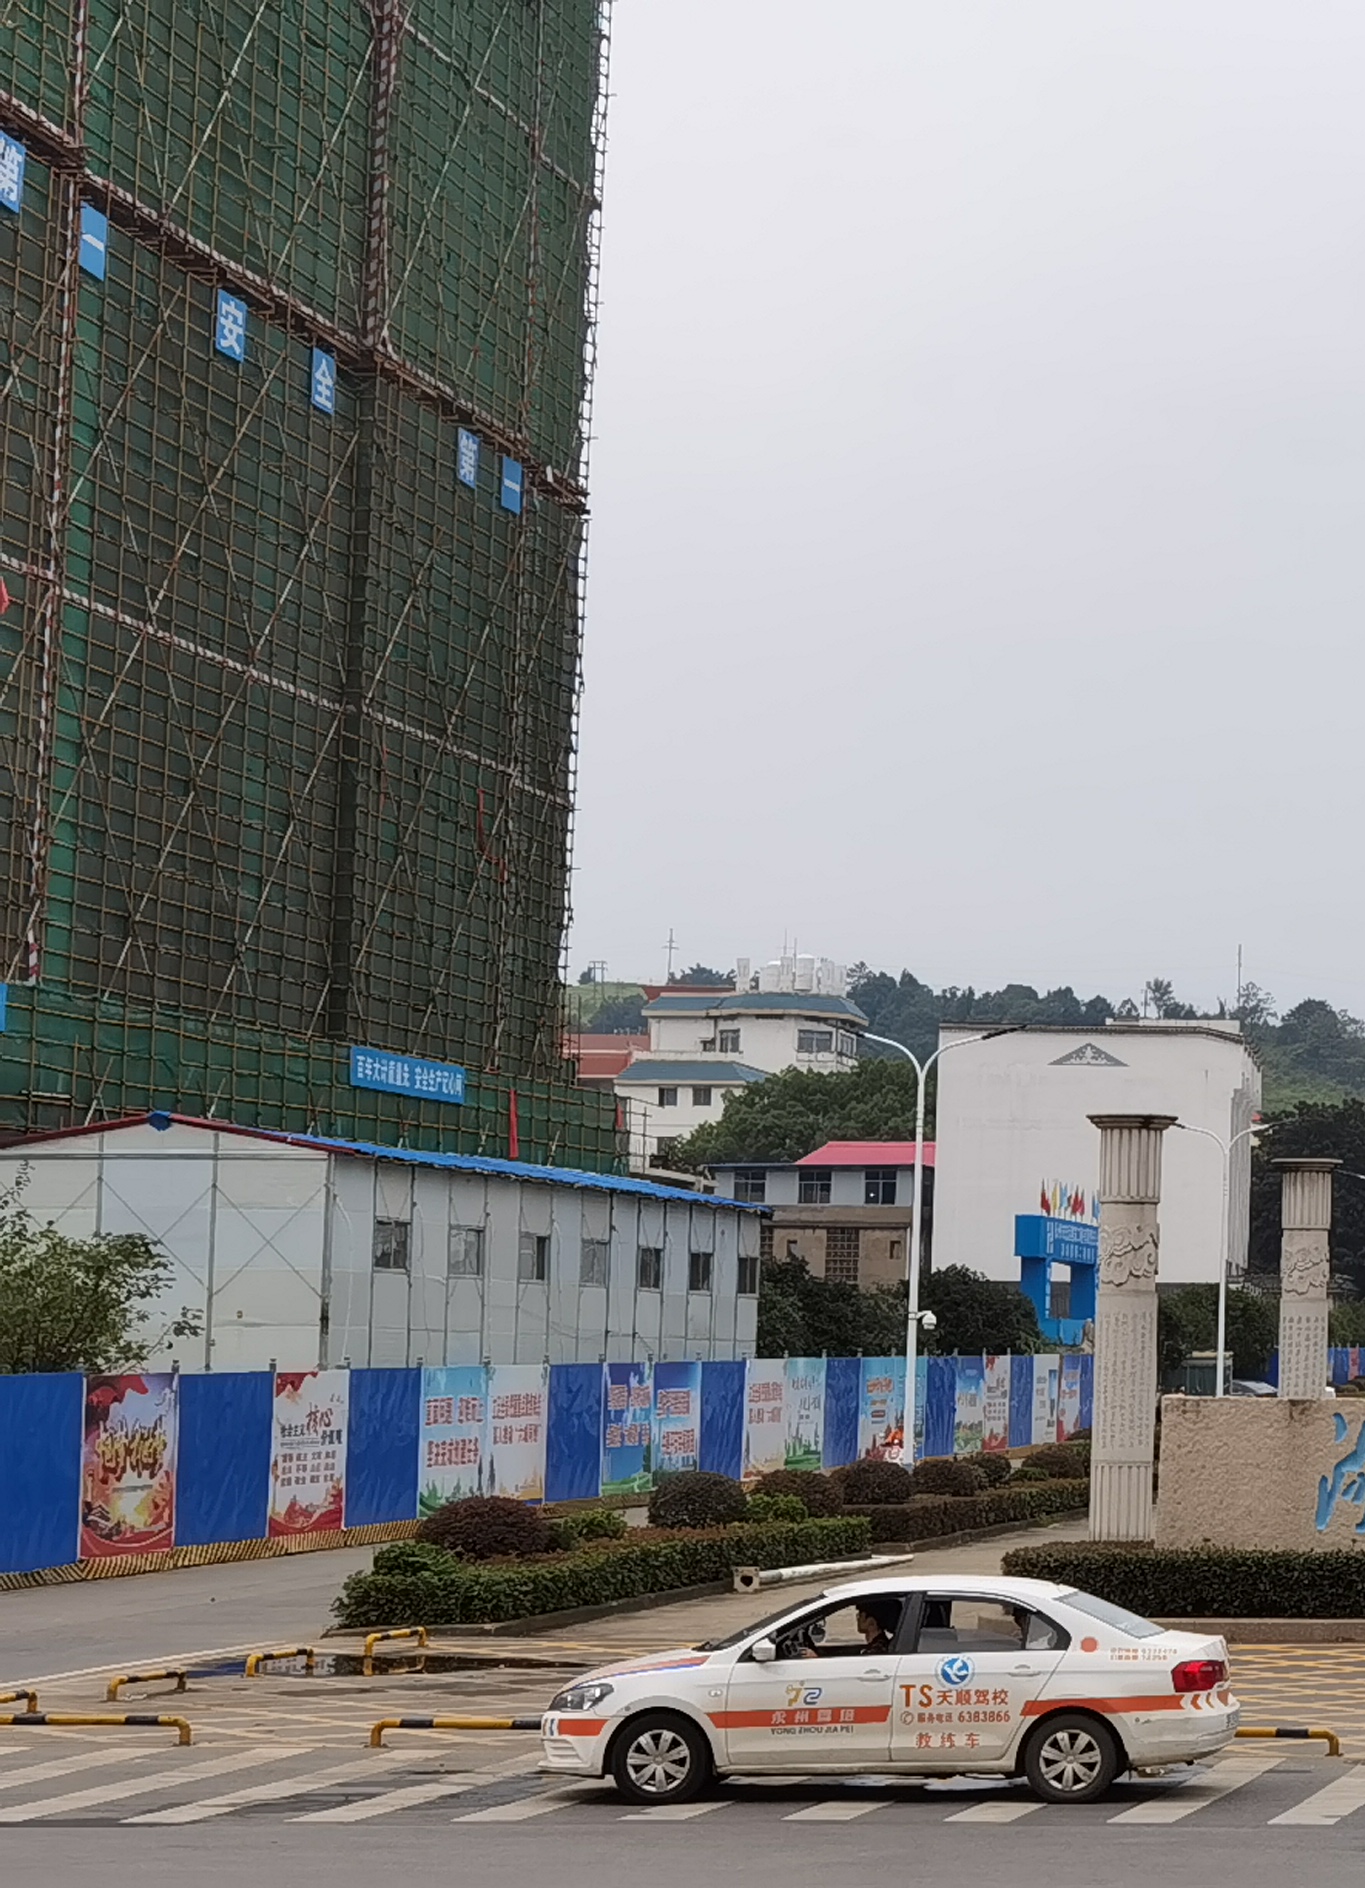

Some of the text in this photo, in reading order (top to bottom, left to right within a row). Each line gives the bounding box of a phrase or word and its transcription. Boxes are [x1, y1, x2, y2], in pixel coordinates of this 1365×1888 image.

[899, 1684, 1009, 1708] TS 天顺驾校
[798, 1726, 823, 1735] ZHOU
[916, 1732, 981, 1750] 教练车
